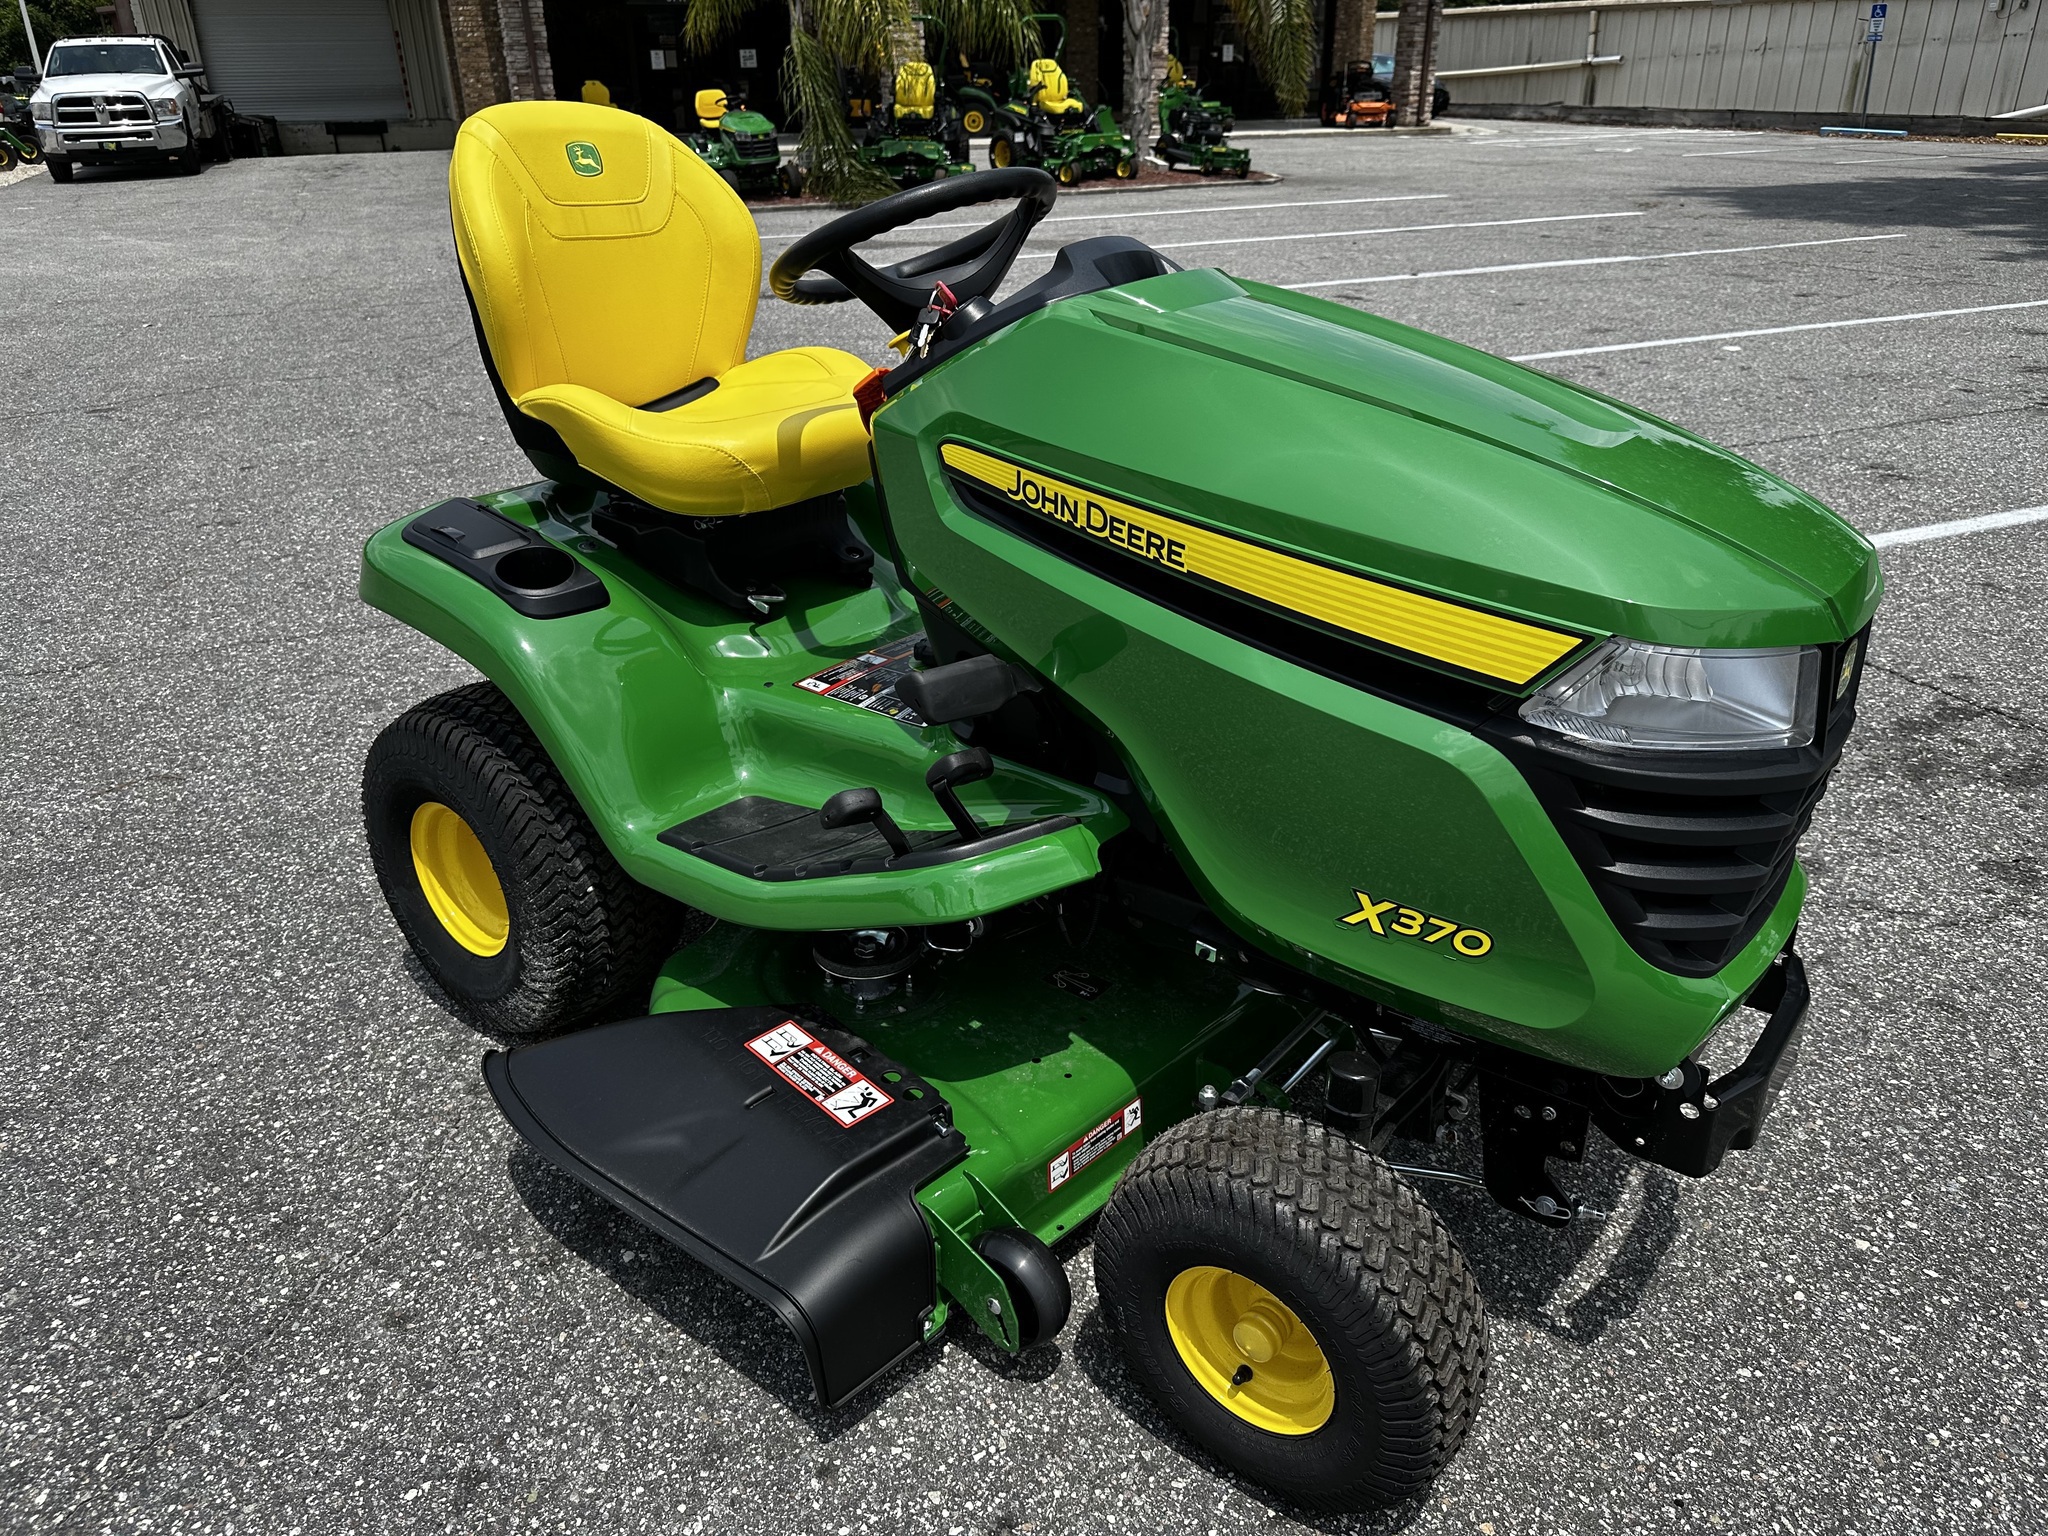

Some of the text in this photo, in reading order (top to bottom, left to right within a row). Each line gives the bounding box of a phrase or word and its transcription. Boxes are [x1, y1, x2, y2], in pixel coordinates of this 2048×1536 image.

[1006, 469, 1187, 569] JOHN DEERE
[1337, 888, 1494, 957] X370
[821, 1050, 858, 1079] DANGER
[1088, 1118, 1112, 1139] DANGER
